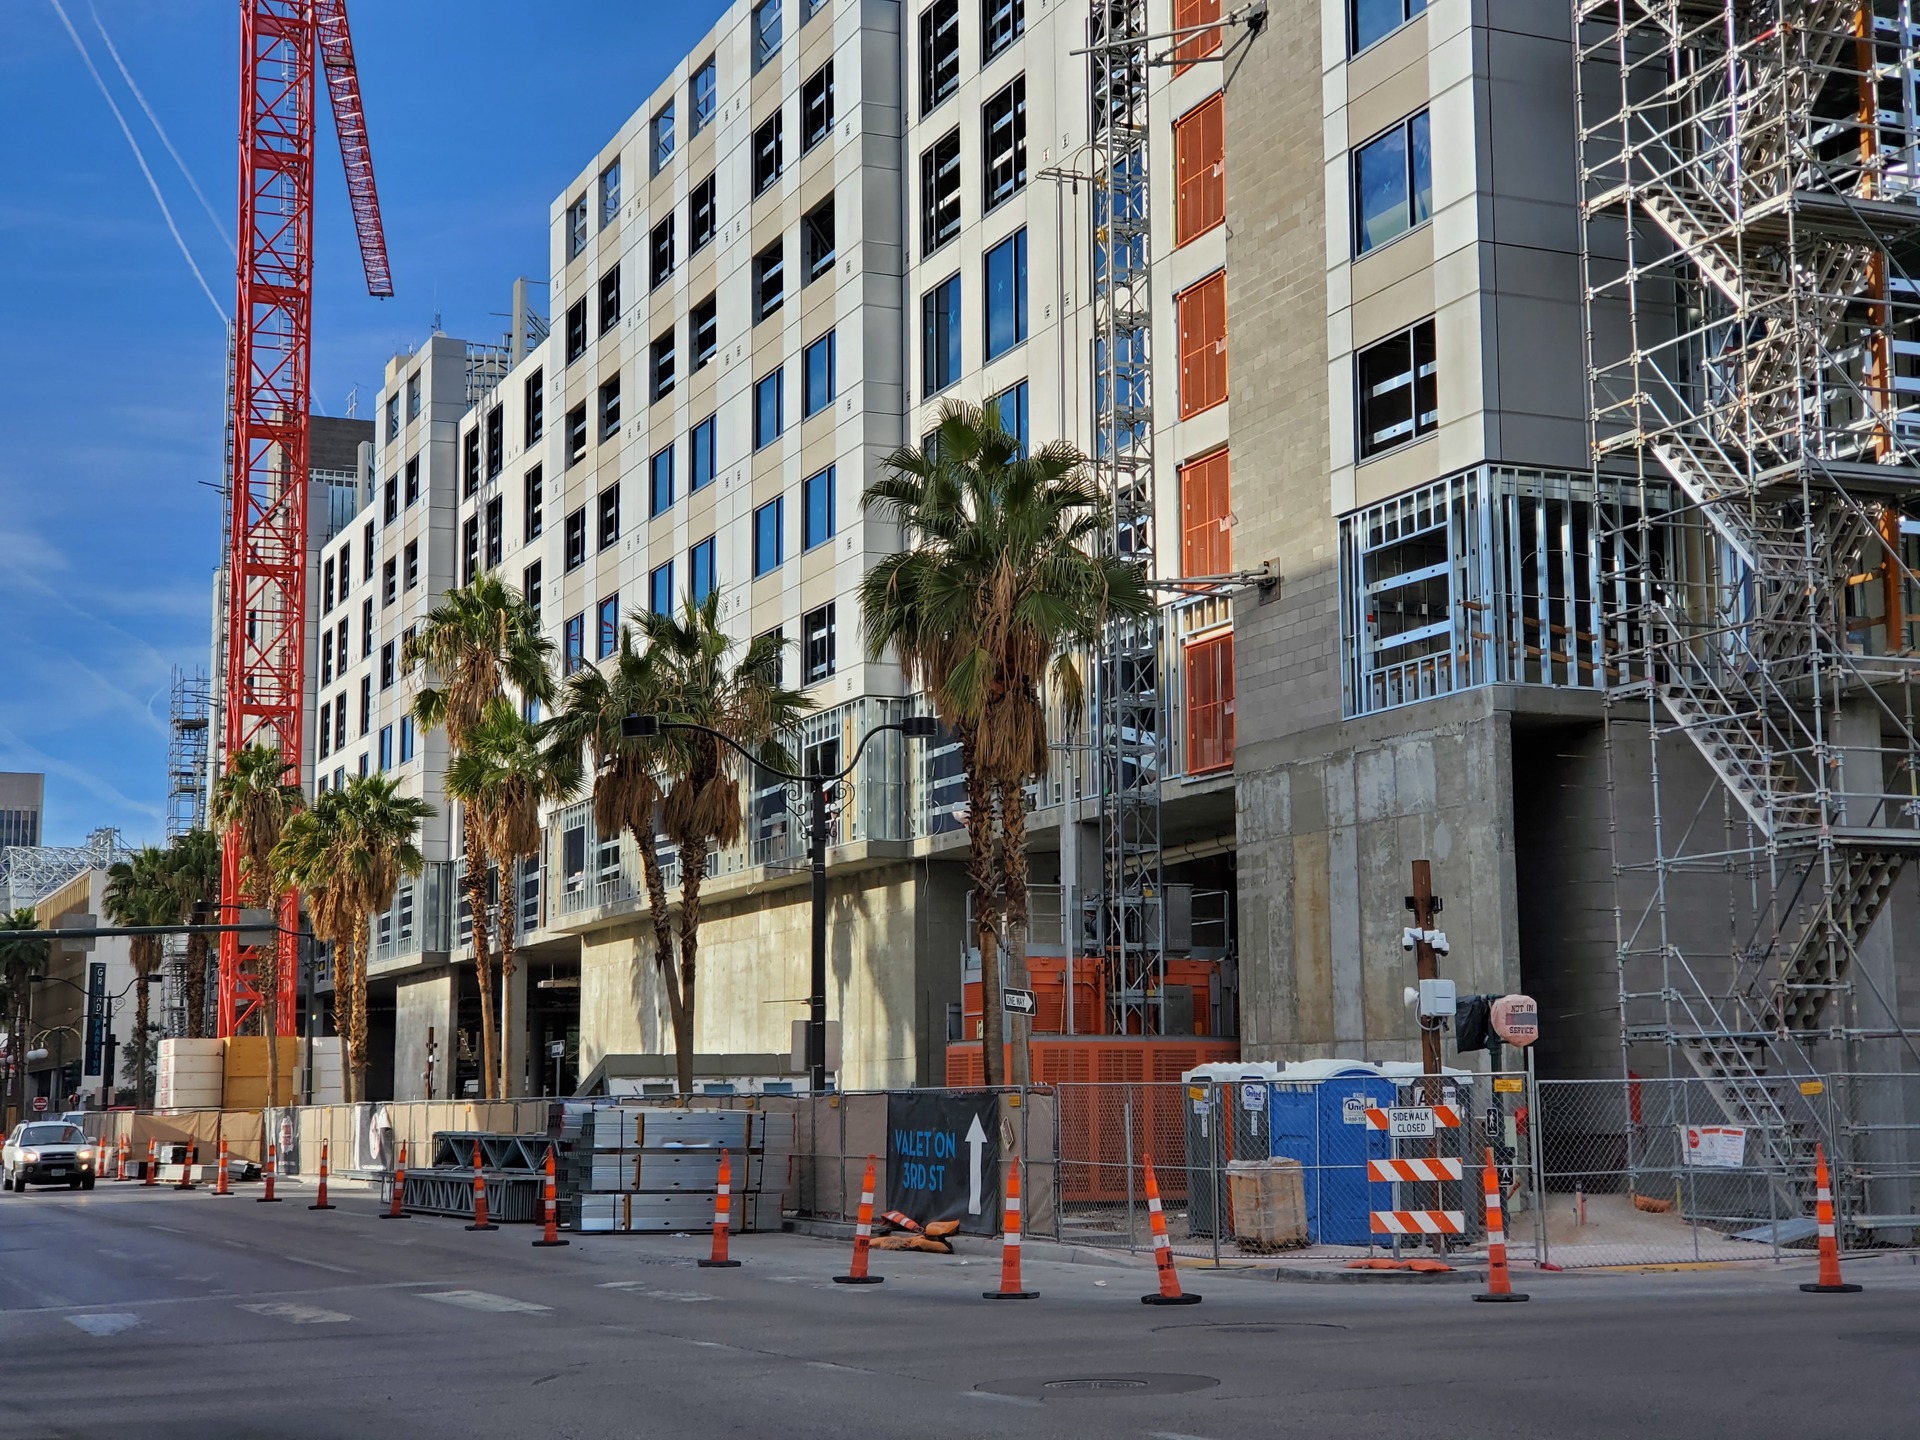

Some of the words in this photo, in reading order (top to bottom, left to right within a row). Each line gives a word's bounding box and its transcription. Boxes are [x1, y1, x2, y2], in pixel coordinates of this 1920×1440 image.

[1006, 995, 1016, 1006] ONE
[1016, 996, 1025, 1007] WAY
[1511, 1004, 1524, 1013] NOT
[1526, 1004, 1534, 1012] IN
[1509, 1026, 1534, 1035] SERVICE
[92, 1020, 102, 1075] PARKING
[1392, 1111, 1430, 1122] SIDEWALK
[1397, 1123, 1426, 1133] CLOSED
[895, 1129, 931, 1157] VALET
[934, 1131, 956, 1159] ON
[902, 1162, 926, 1190] 3RD
[929, 1164, 945, 1192] ST
